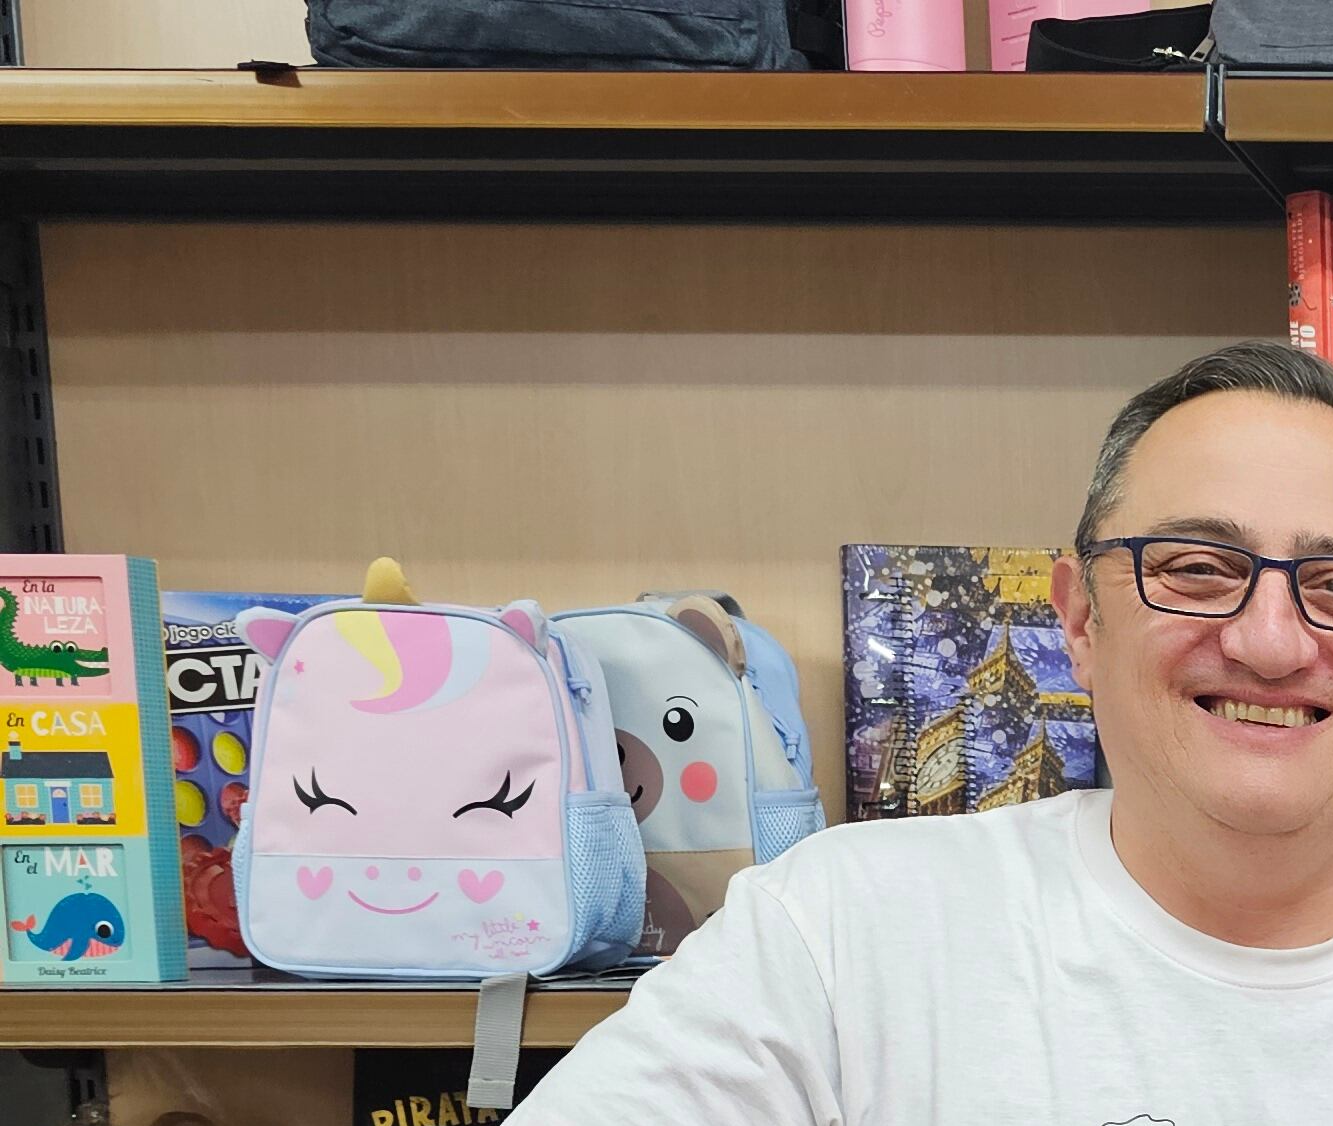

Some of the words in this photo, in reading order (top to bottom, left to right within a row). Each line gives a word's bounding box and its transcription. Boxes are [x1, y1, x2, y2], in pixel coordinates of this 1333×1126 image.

[22, 580, 39, 593] En
[40, 580, 55, 593] la
[44, 616, 98, 634] LEZA
[7, 712, 24, 728] En
[31, 711, 107, 737] CASA
[14, 850, 30, 865] En
[44, 846, 118, 877] MAR
[26, 862, 38, 875] el
[38, 966, 66, 980] Daisy
[68, 965, 108, 978] Beatrice
